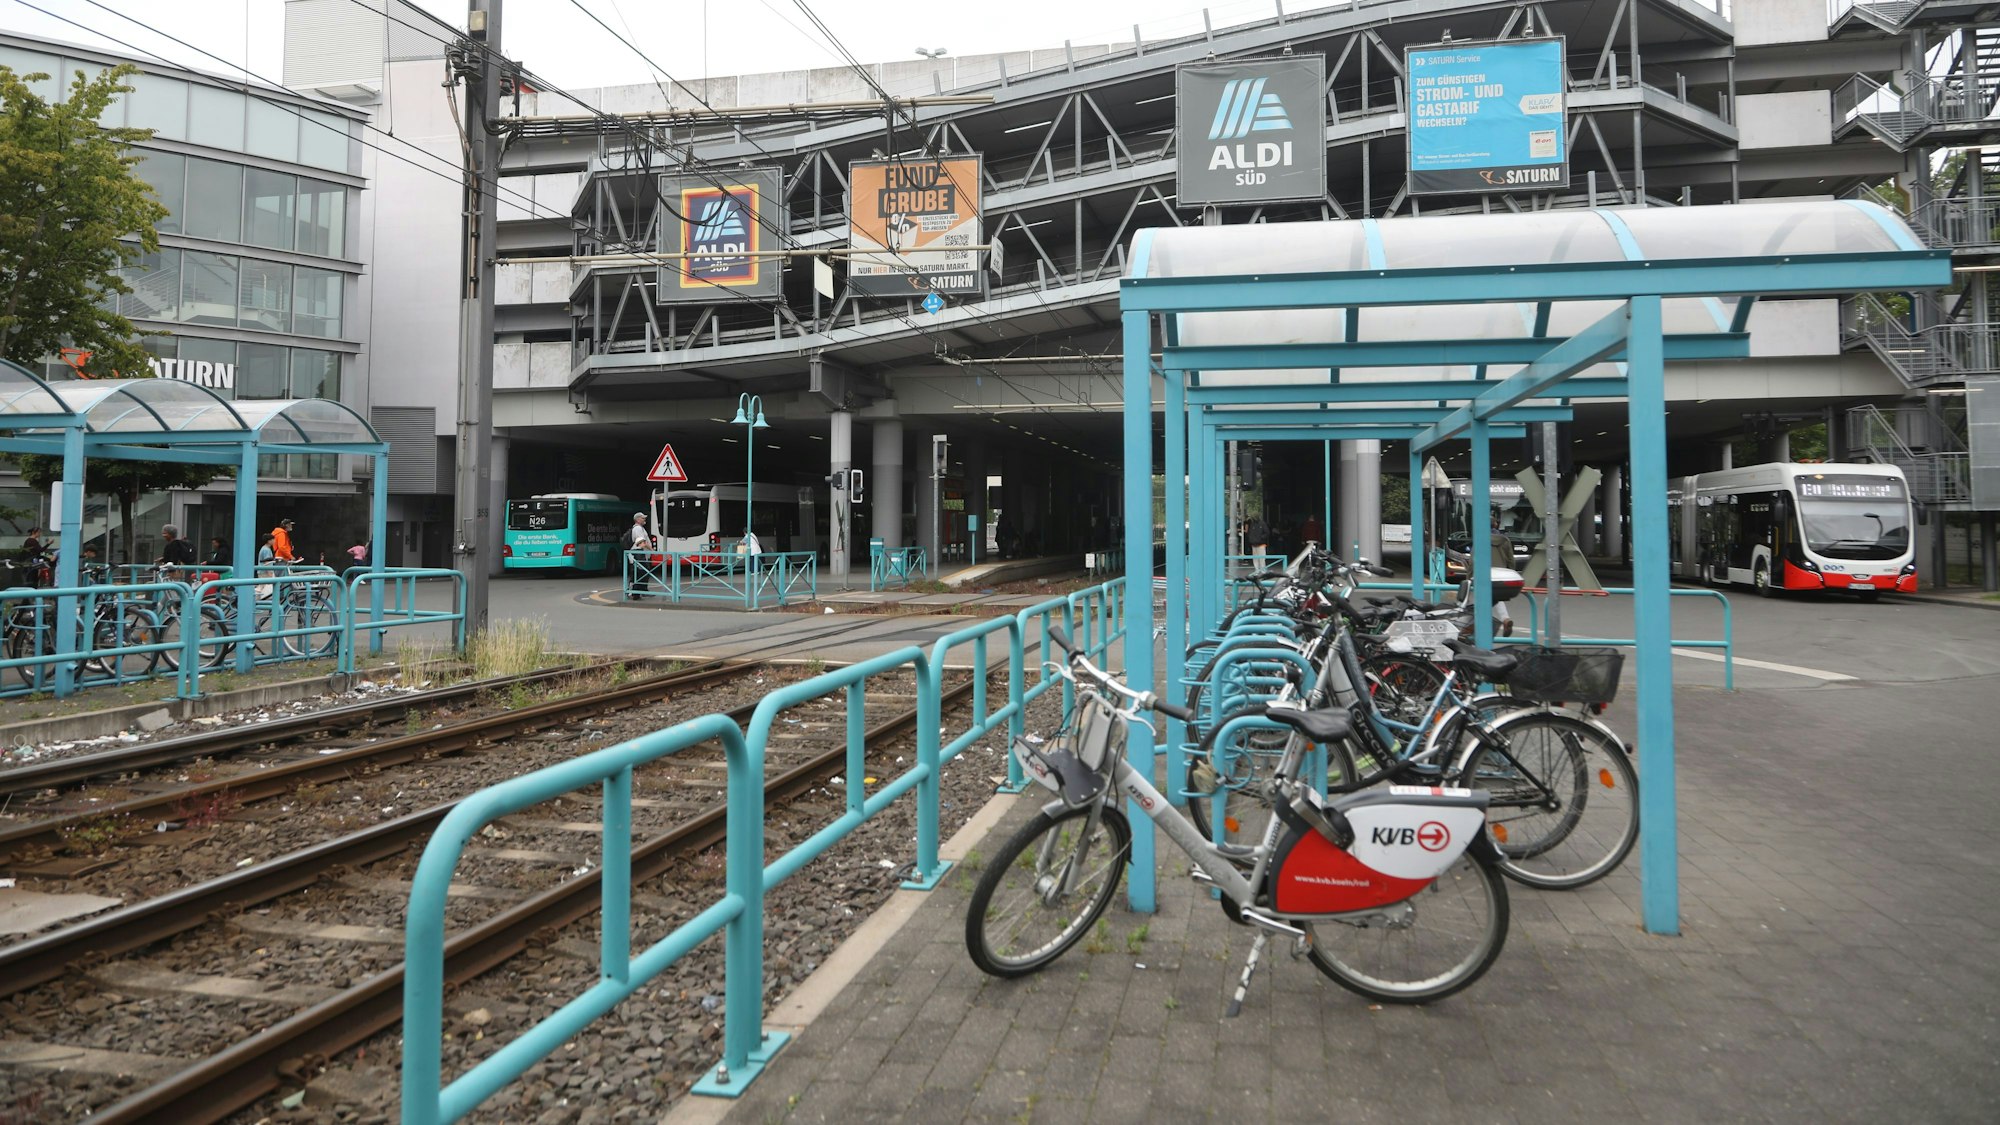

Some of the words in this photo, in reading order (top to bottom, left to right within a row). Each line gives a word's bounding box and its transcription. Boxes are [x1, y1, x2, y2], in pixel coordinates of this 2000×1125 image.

[1428, 56, 1455, 65] SATURN
[1457, 55, 1480, 63] Service
[1416, 78, 1434, 87] ZUM
[1438, 74, 1485, 86] GÜNSTIGEN
[1417, 86, 1470, 101] STROM-
[1475, 84, 1503, 98] UND
[1417, 101, 1480, 116] GASTARIF
[1417, 118, 1467, 127] WECHSELN?
[1208, 142, 1292, 170] ALDI
[1235, 169, 1266, 186] SÜD
[1507, 168, 1560, 184] SATURN
[884, 189, 948, 213] GRUBE
[694, 243, 745, 262] ALDI
[930, 275, 973, 288] SATURN
[1460, 484, 1466, 494] E
[529, 516, 546, 526] N26
[1372, 827, 1415, 846] KVB
